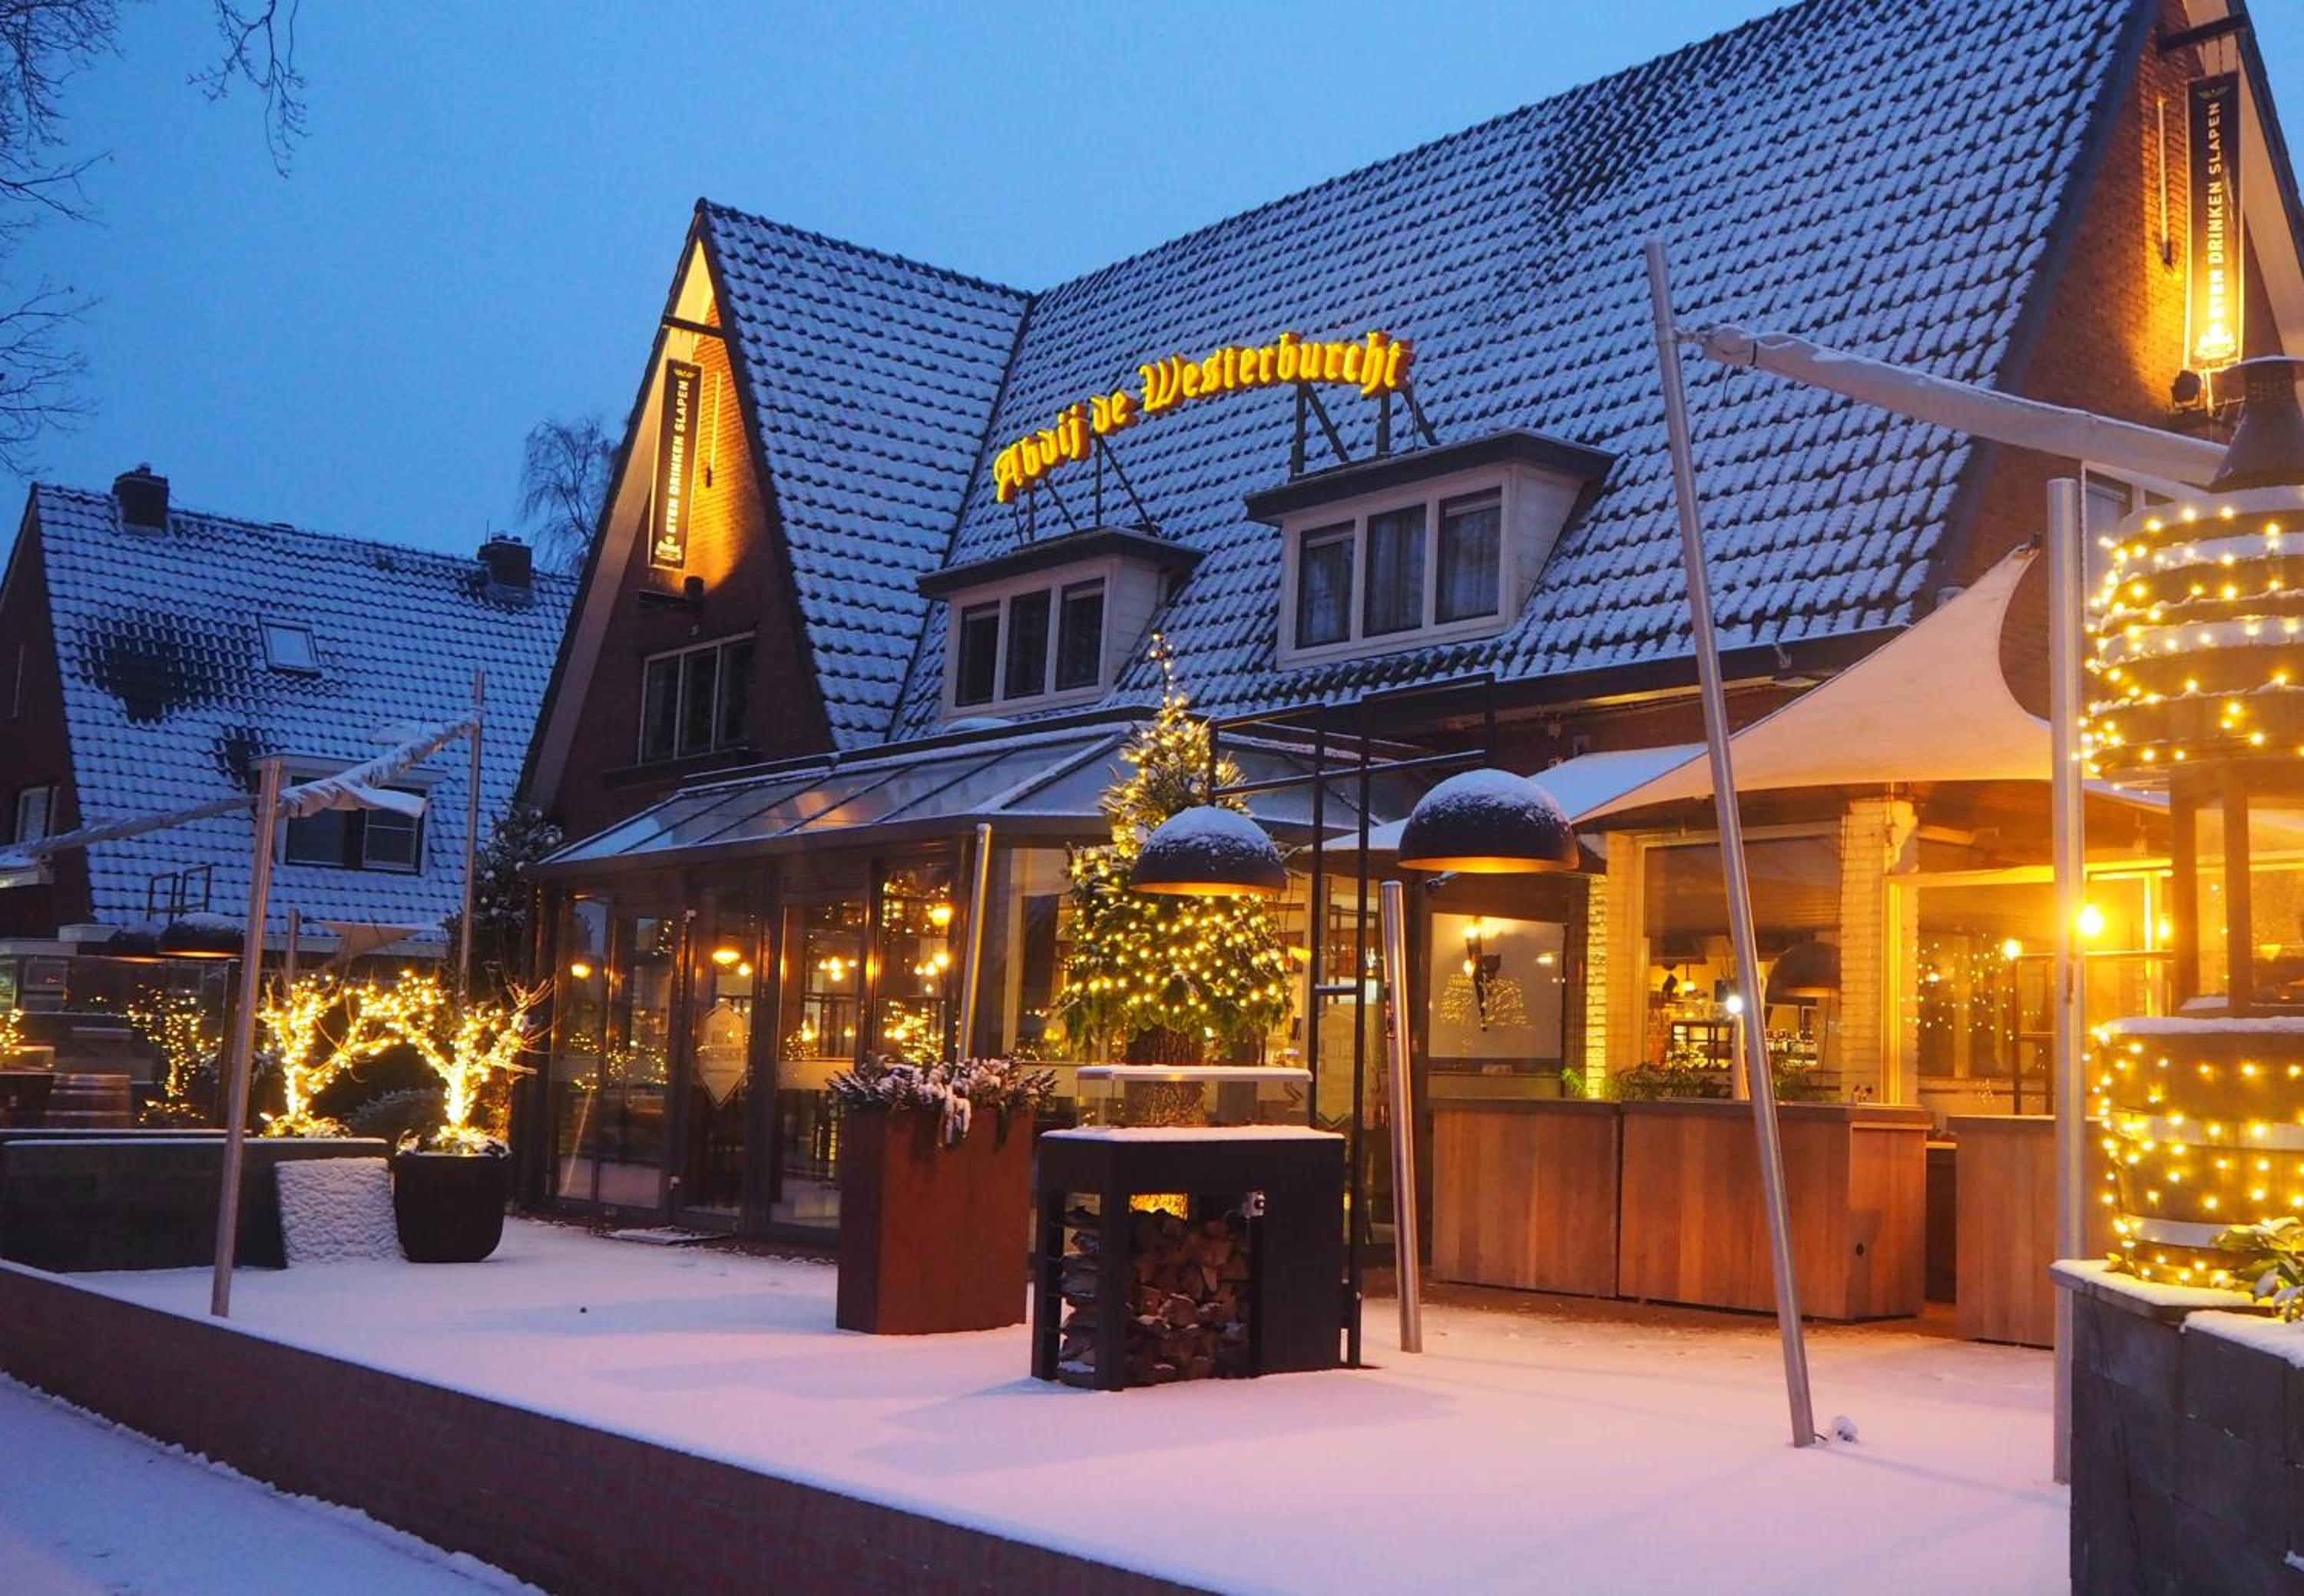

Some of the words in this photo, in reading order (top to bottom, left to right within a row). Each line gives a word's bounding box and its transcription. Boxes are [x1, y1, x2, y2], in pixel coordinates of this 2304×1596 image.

[2208, 101, 2222, 176] SLAPEN
[2208, 184, 2223, 264] DRINKEN
[675, 381, 689, 432] SLAPEN
[993, 406, 1091, 503] Abdij
[1091, 389, 1134, 432] de
[1140, 332, 1412, 413] Westerburcht
[669, 435, 684, 495] DRINKEN
[667, 498, 679, 533] ETEN
